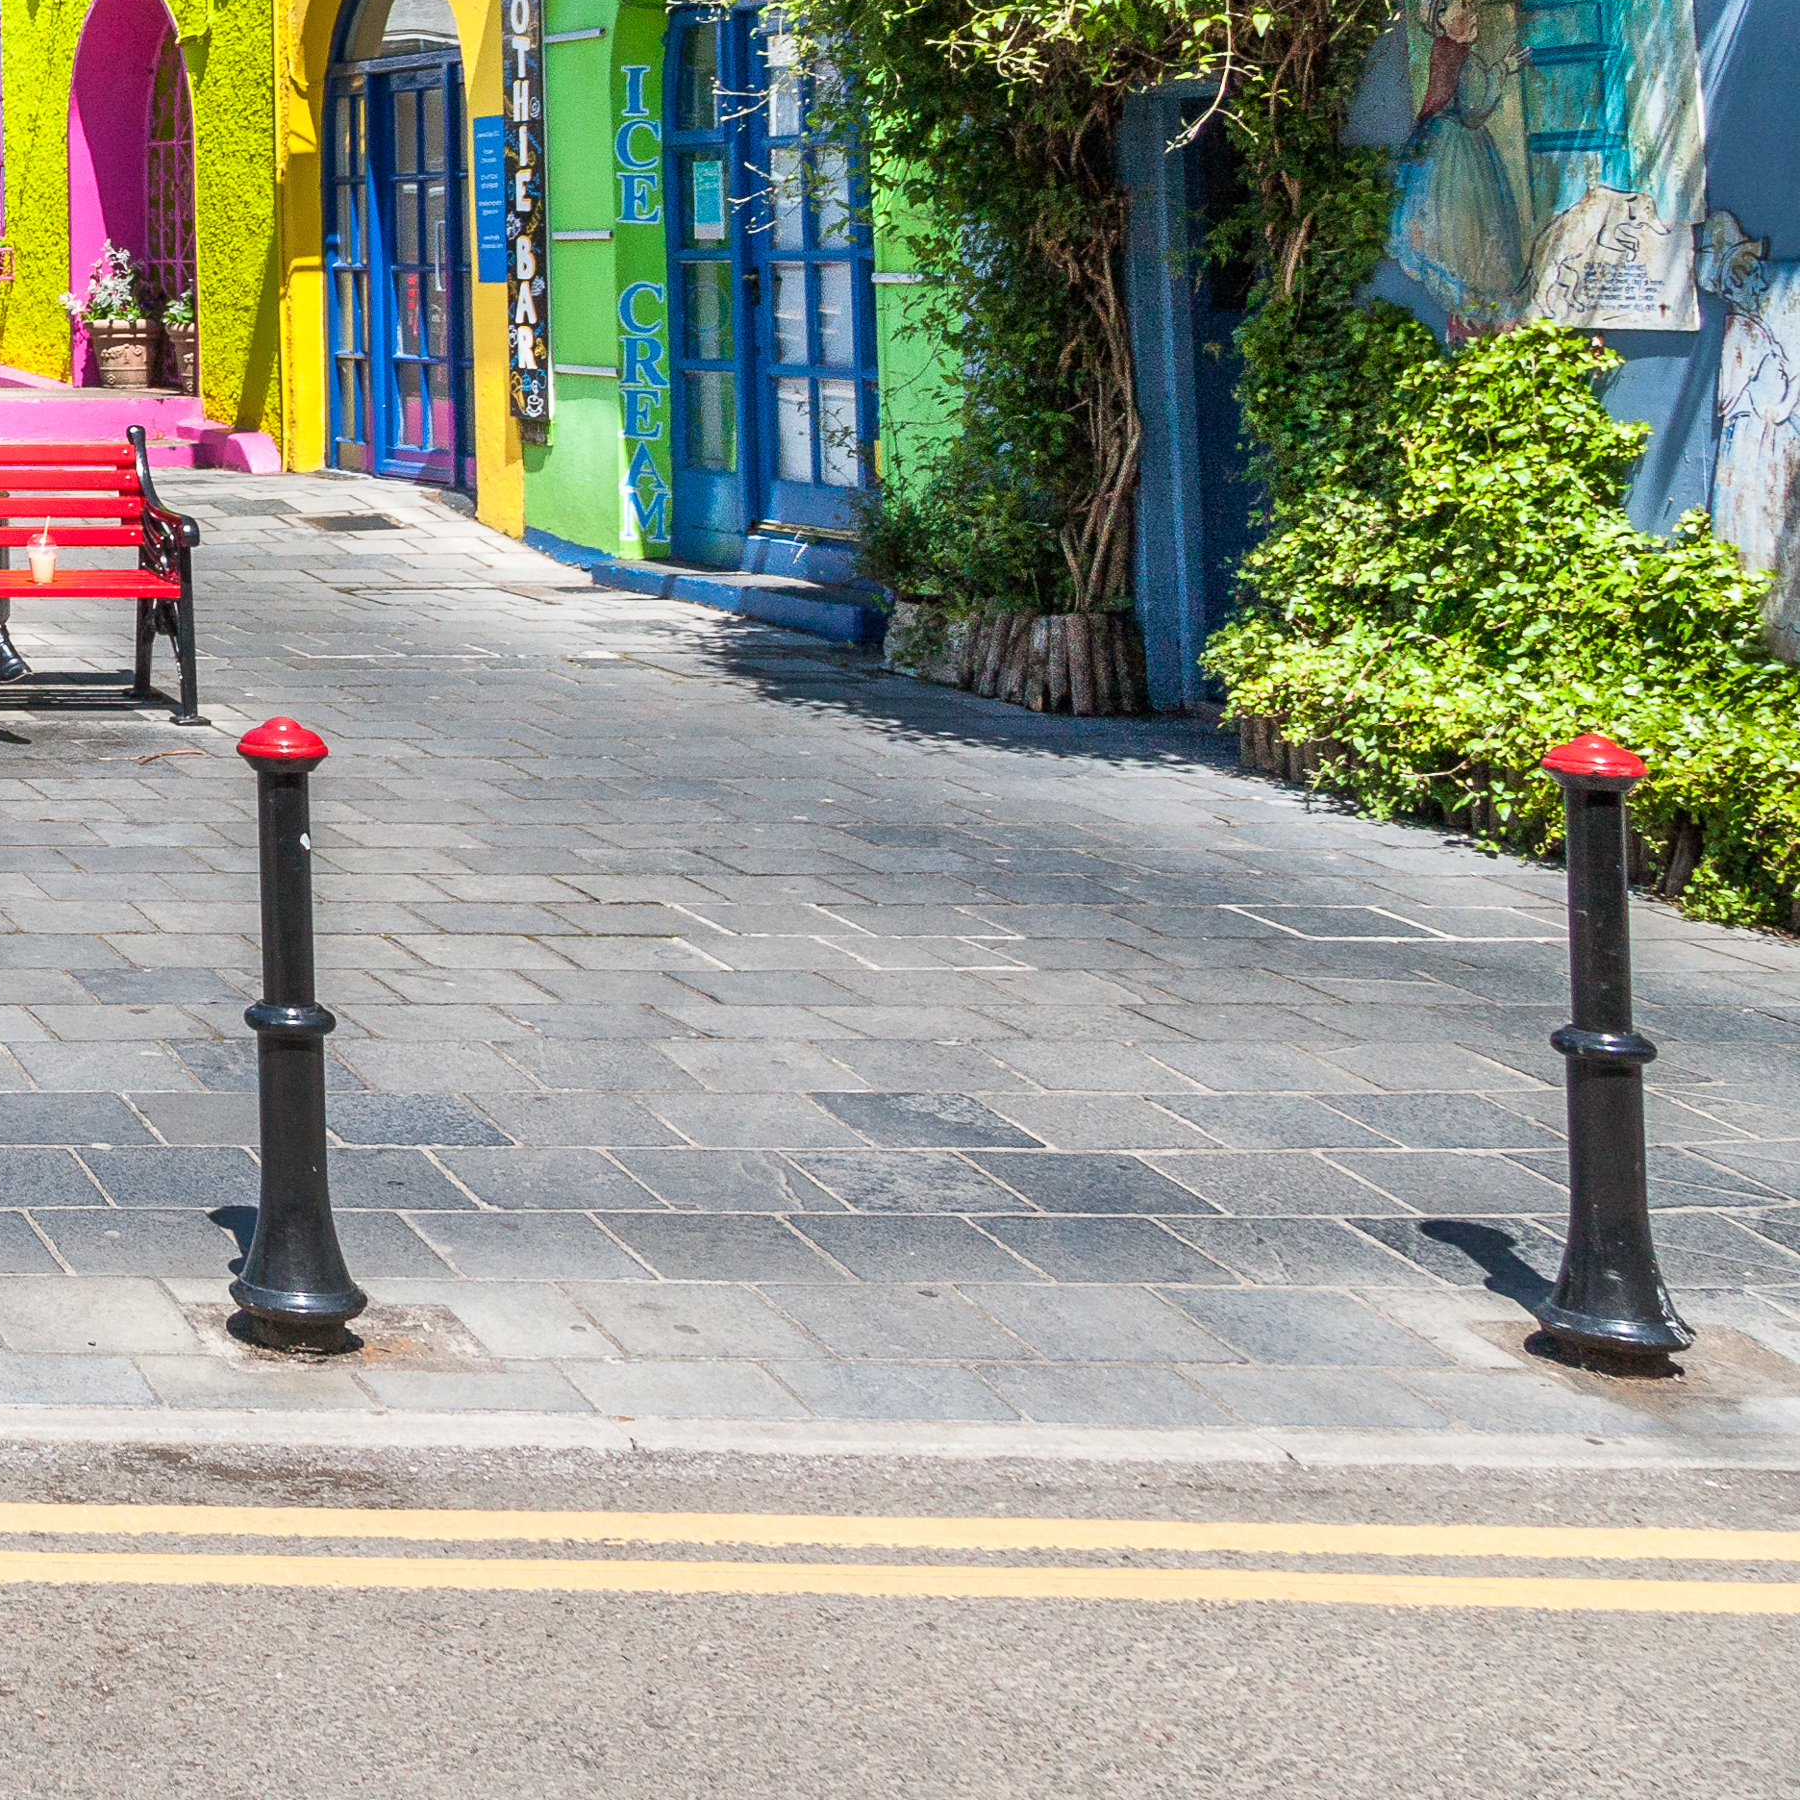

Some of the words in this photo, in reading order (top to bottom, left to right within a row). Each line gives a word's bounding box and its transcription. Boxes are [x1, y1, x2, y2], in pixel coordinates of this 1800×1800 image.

[614, 65, 662, 224] ICE
[515, 236, 537, 369] BAR
[618, 281, 672, 541] CREAM
